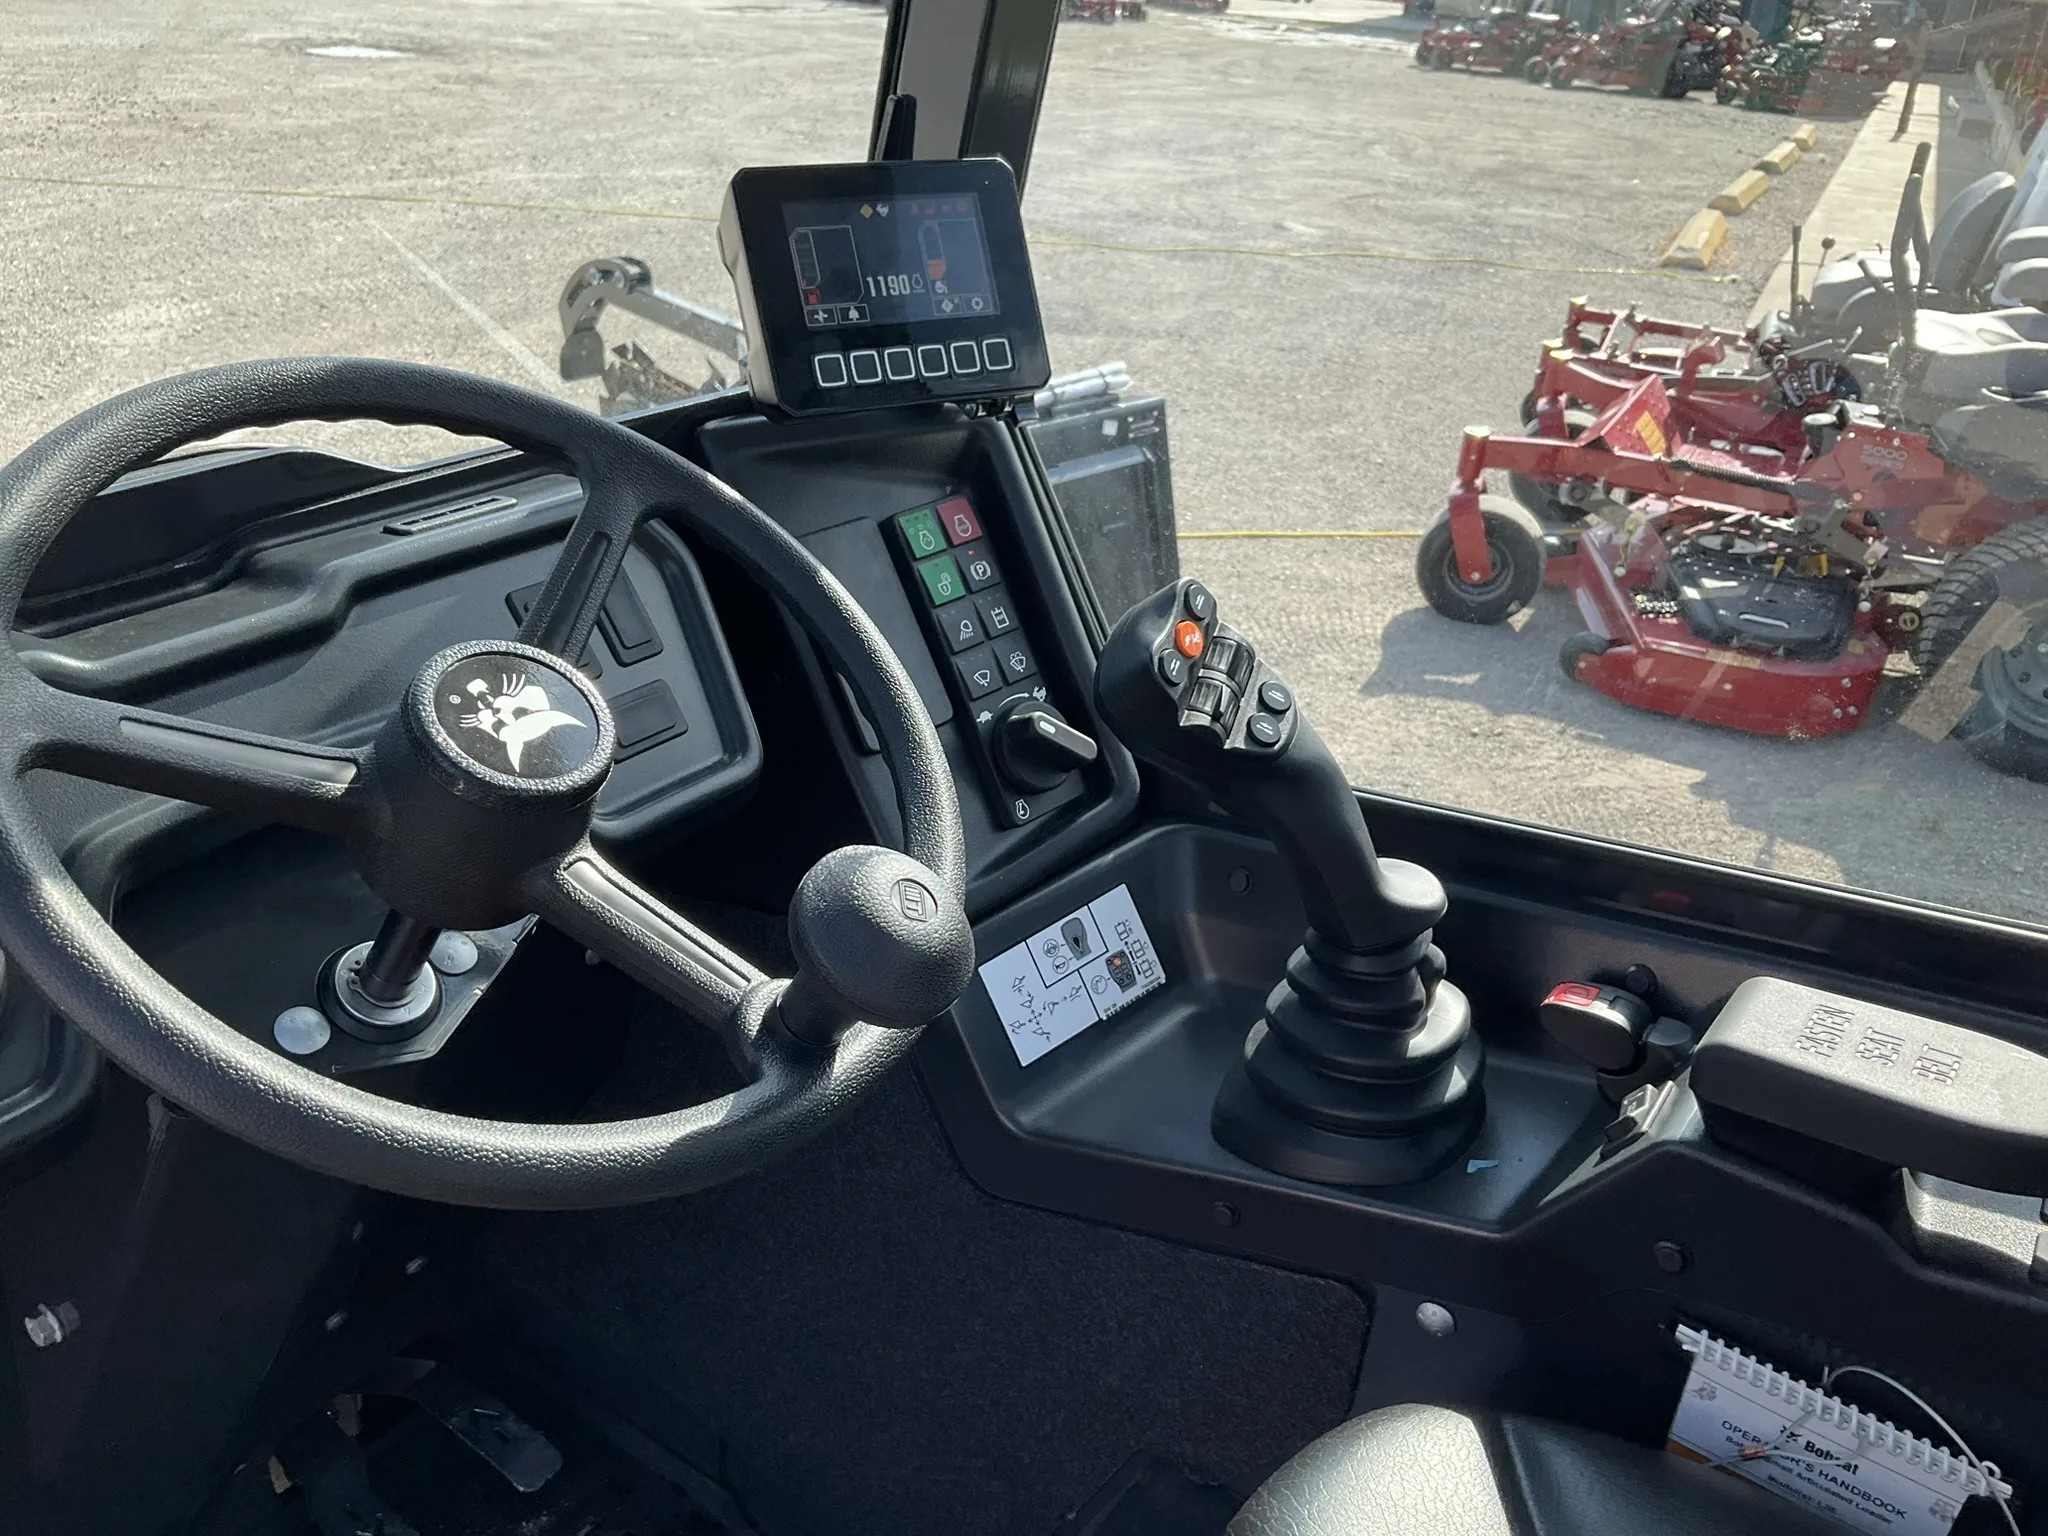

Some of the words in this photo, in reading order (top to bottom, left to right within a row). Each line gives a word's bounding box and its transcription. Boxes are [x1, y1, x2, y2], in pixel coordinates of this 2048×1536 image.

[866, 274, 911, 298] 1190
[1863, 444, 1908, 460] 5000
[1794, 1003, 1855, 1058] FASTEN
[1855, 1026, 1905, 1067] SEAT
[1912, 1043, 1962, 1085] BELT
[1818, 1469, 1907, 1520] HANDBOOK
